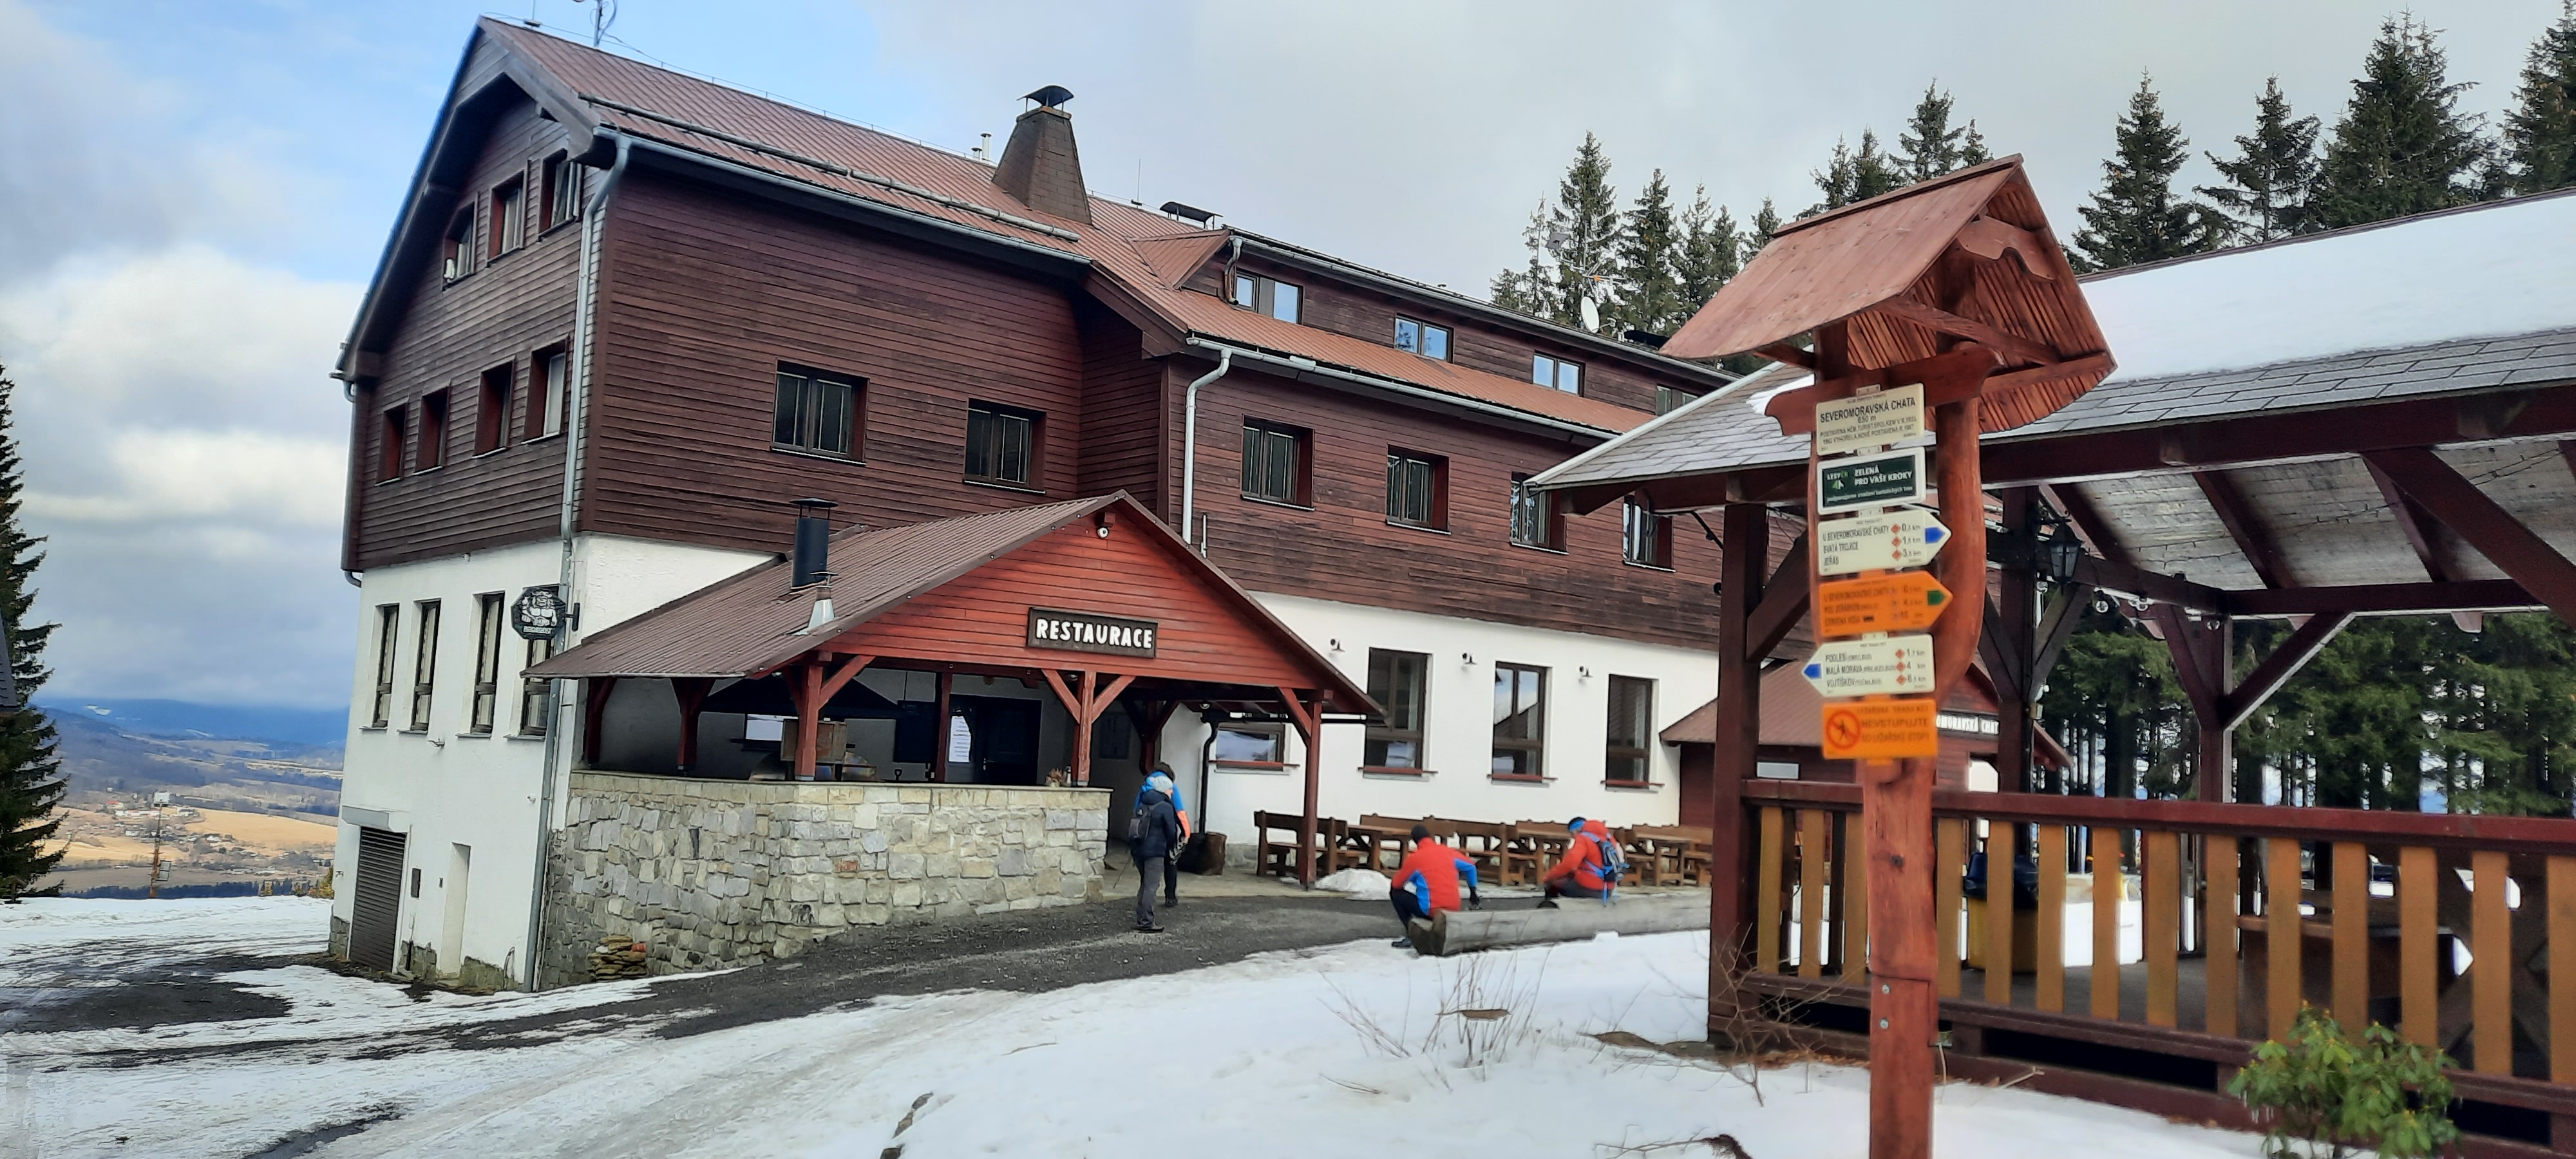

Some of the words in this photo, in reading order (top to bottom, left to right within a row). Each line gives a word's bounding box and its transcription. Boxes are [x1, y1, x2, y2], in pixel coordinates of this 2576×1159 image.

[1821, 400, 1889, 423] SEVEROMORAVSKÁ
[1891, 397, 1916, 411] CHATA
[1854, 464, 1880, 477] ZELENÁ
[1855, 477, 1868, 485] PRO
[1870, 474, 1887, 484] VAŠE
[1888, 471, 1913, 481] KROKY
[1036, 618, 1153, 649] RESTAURACE
[1861, 718, 1927, 728] NEVSTUPUJTE
[1936, 714, 1979, 732] OMORAVSKÁ
[1980, 719, 1999, 735] CHAT
